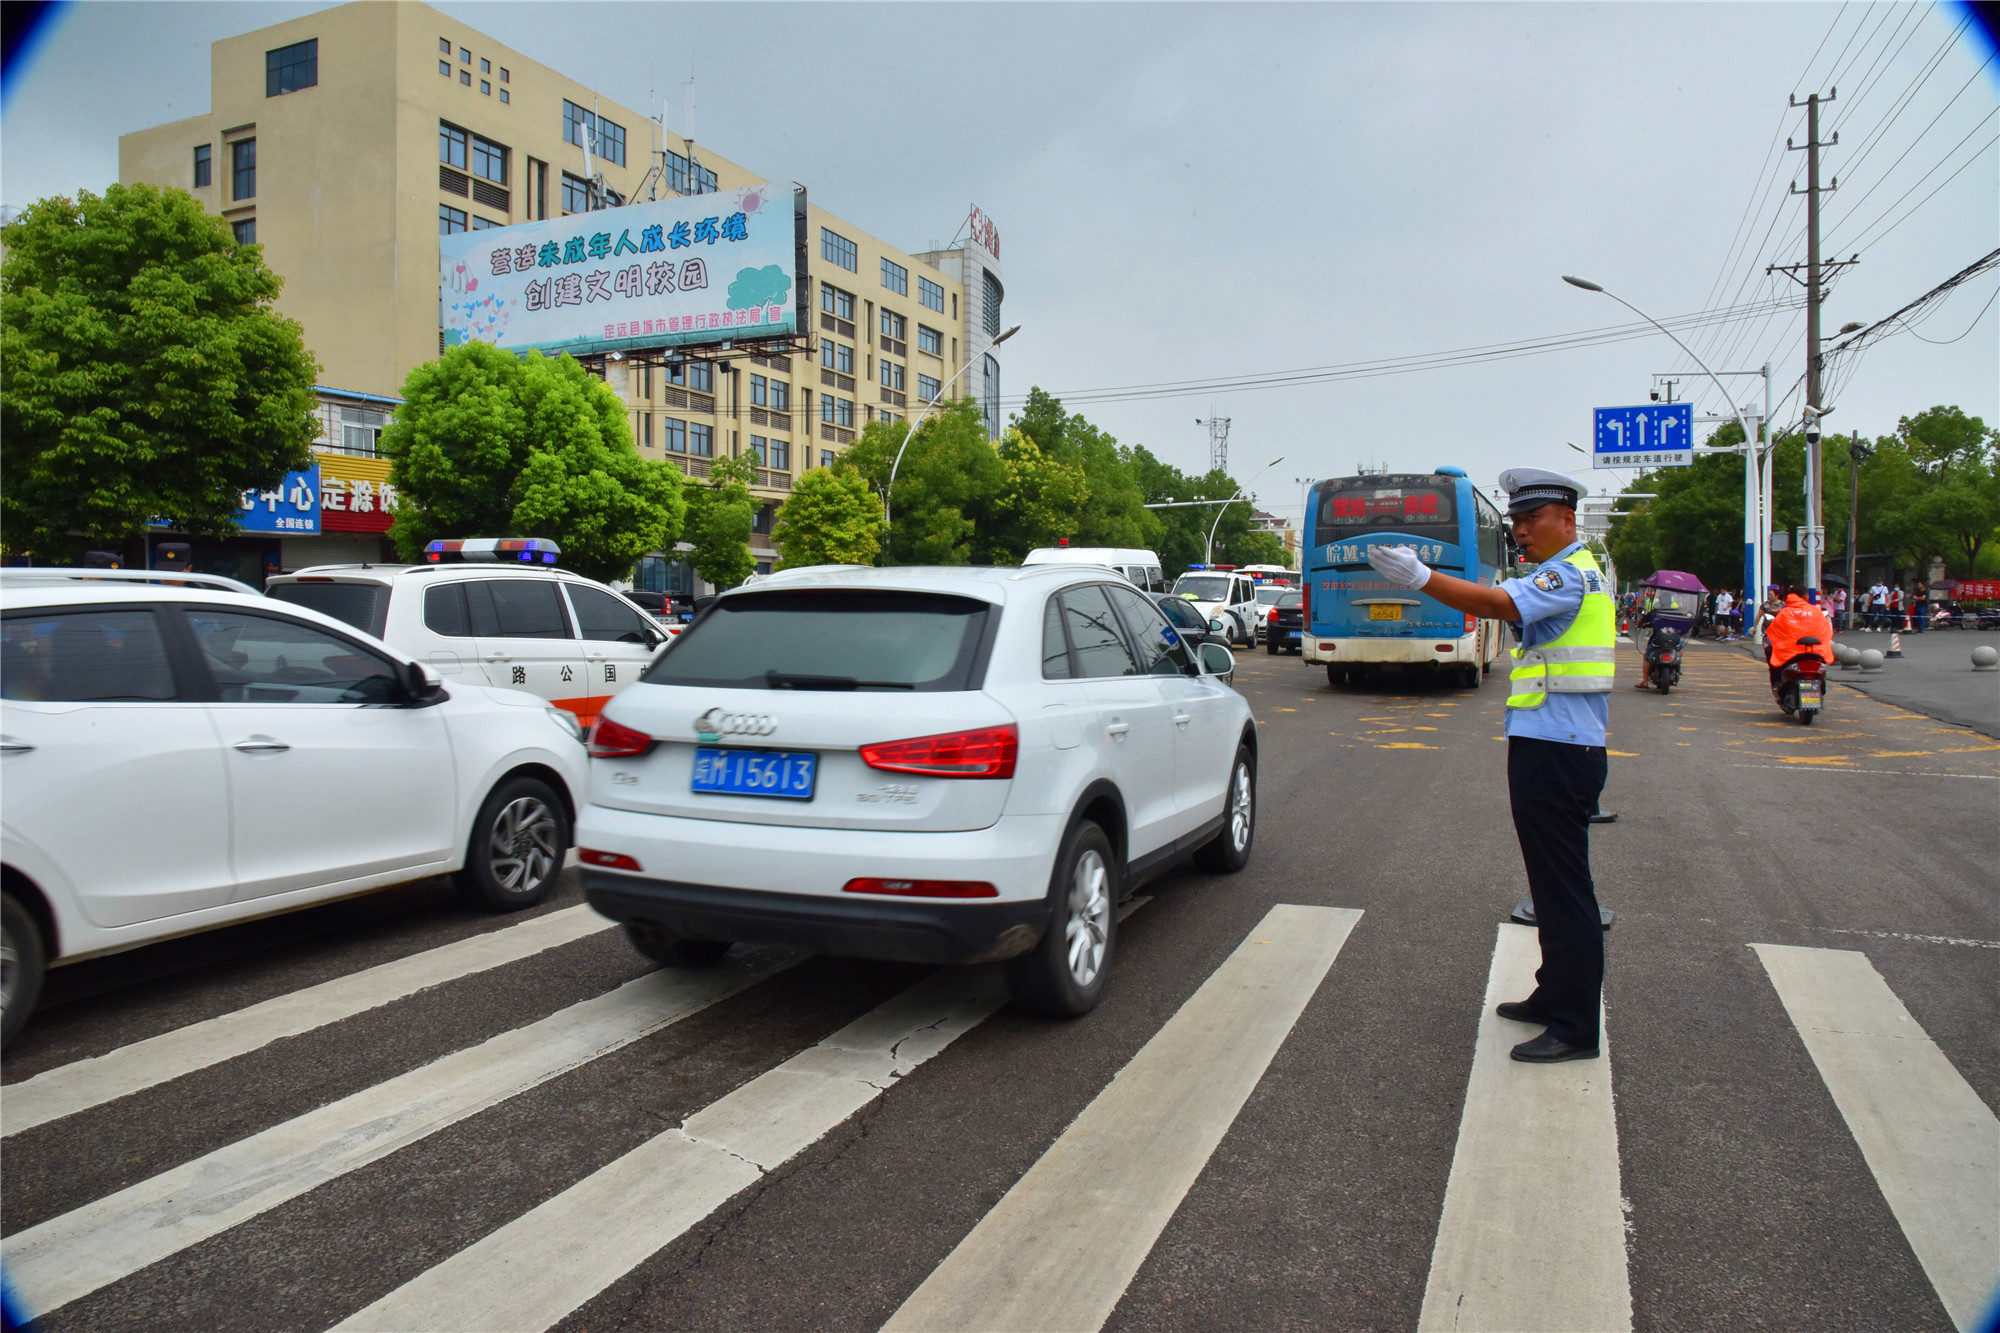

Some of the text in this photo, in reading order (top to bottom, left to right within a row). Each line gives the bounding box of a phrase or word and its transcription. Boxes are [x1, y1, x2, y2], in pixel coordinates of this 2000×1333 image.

[490, 212, 749, 276] 营造未成年人成长环境
[524, 257, 709, 312] 创建文明校园
[603, 308, 762, 341] 定远县城市管理行政执法局
[1602, 452, 1684, 465] 请按规定车道行驶
[275, 517, 314, 530] 全国连锁
